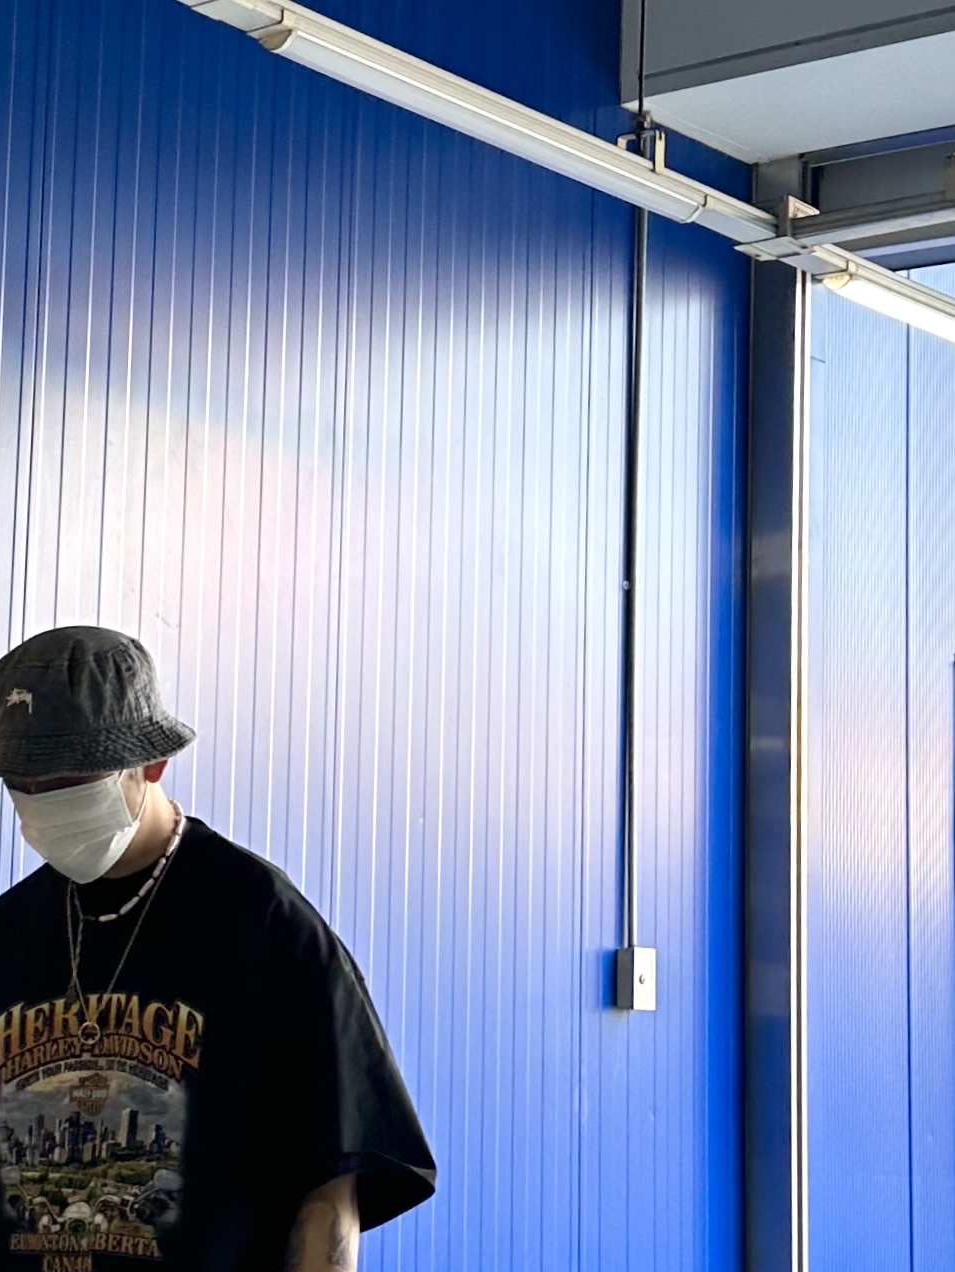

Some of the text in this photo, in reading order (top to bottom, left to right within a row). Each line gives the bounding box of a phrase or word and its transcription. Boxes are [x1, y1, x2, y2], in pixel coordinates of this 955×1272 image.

[3, 1035, 184, 1081] HARLEY-DAVIDSON
[11, 1232, 162, 1259] ENTON BERTA
